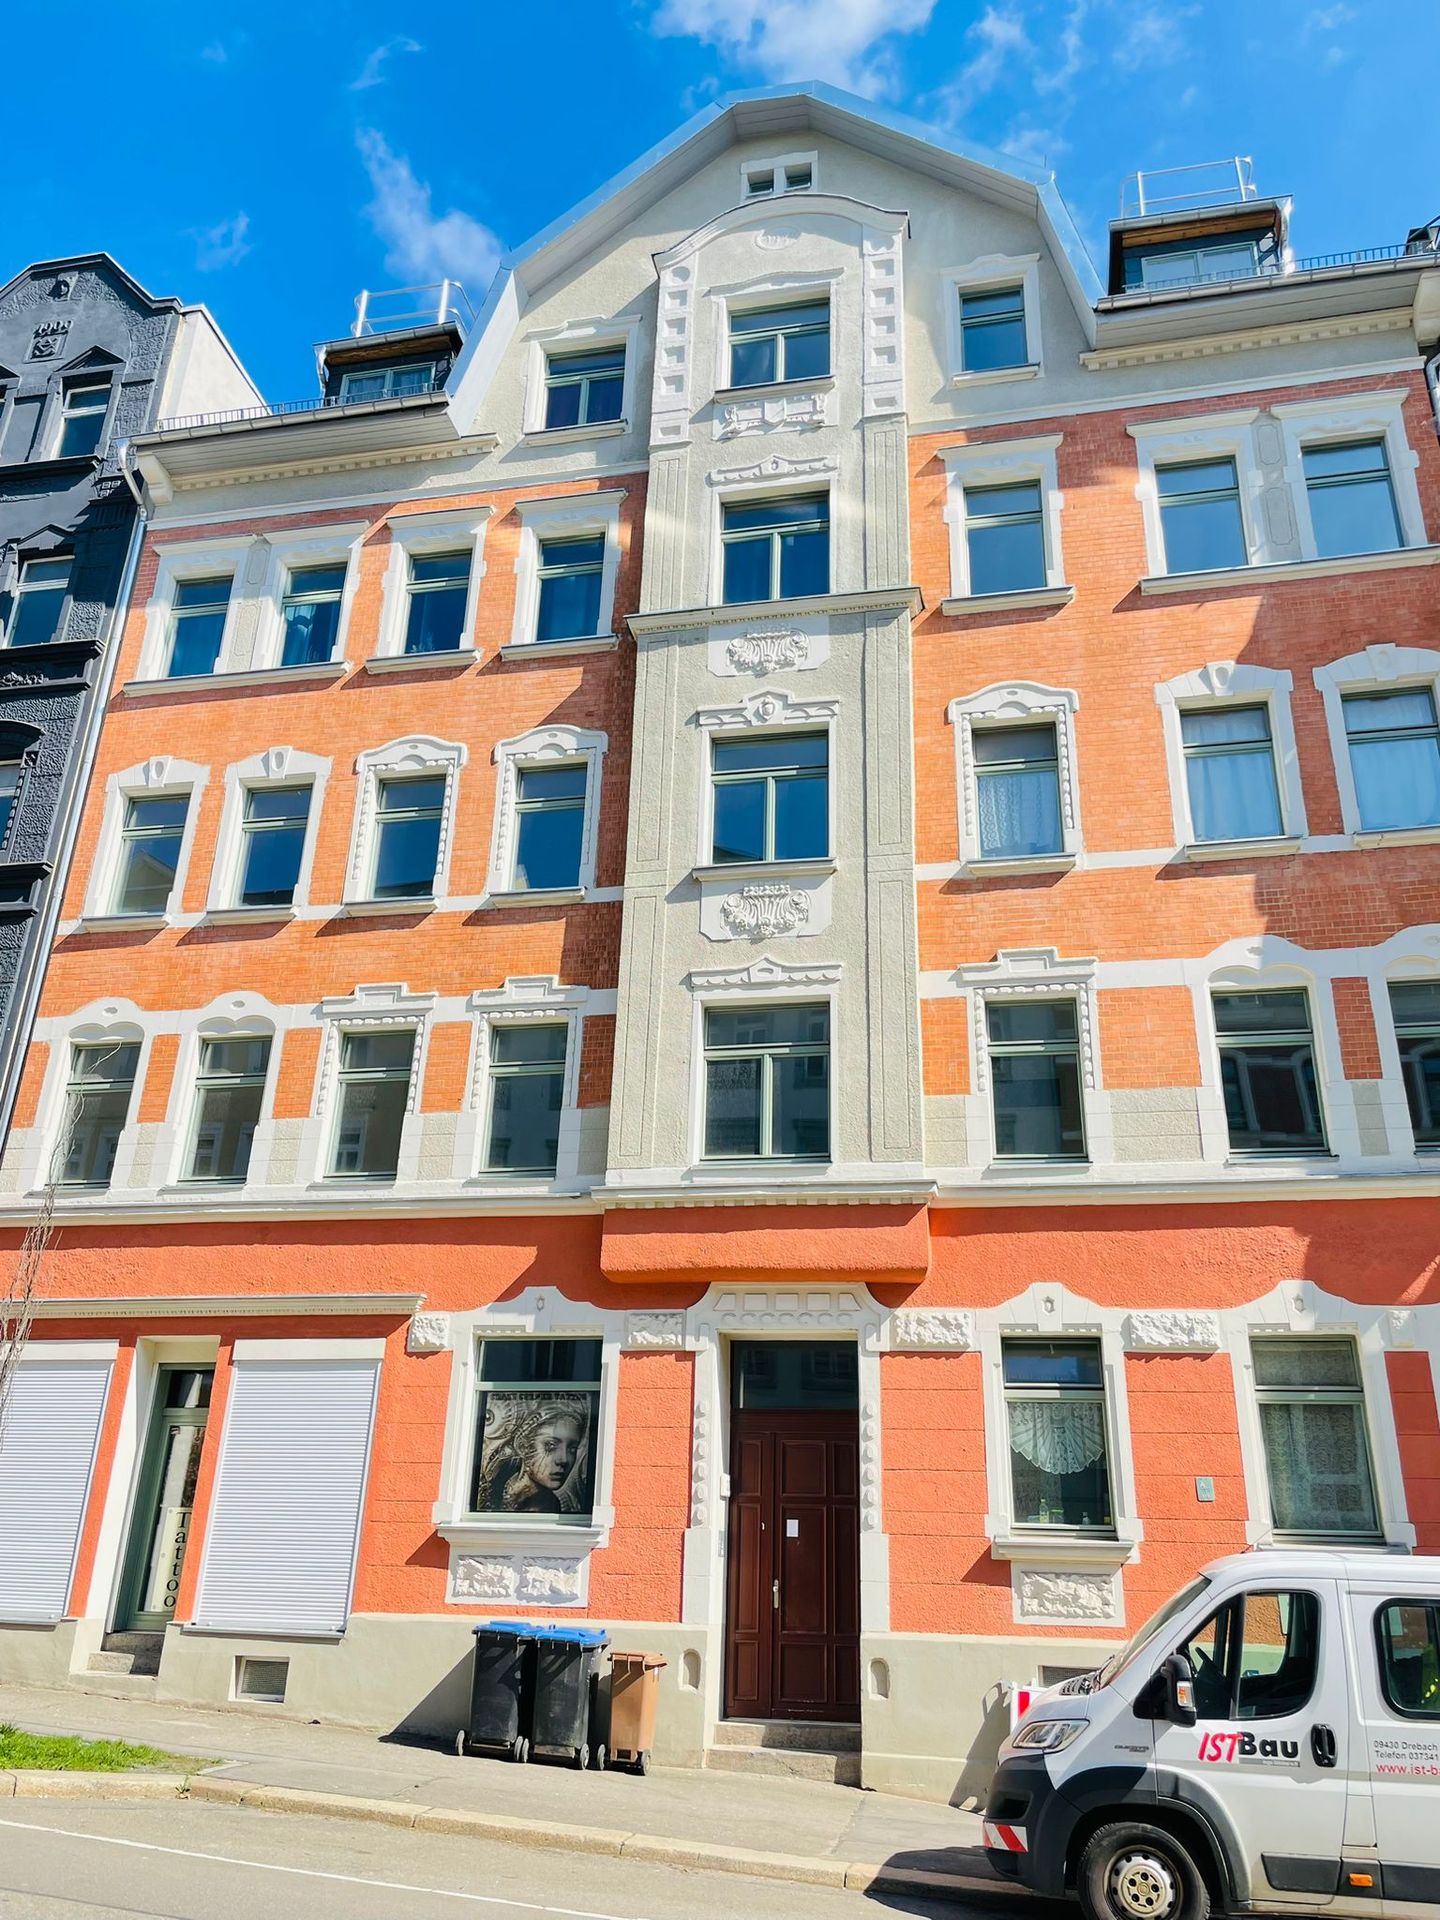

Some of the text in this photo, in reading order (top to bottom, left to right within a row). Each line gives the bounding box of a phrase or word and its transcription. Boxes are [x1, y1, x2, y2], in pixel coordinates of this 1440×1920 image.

[163, 1511, 192, 1608] Tattoo
[1373, 1740, 1438, 1751] 09430 Drebach
[1375, 1750, 1407, 1759] Telefon
